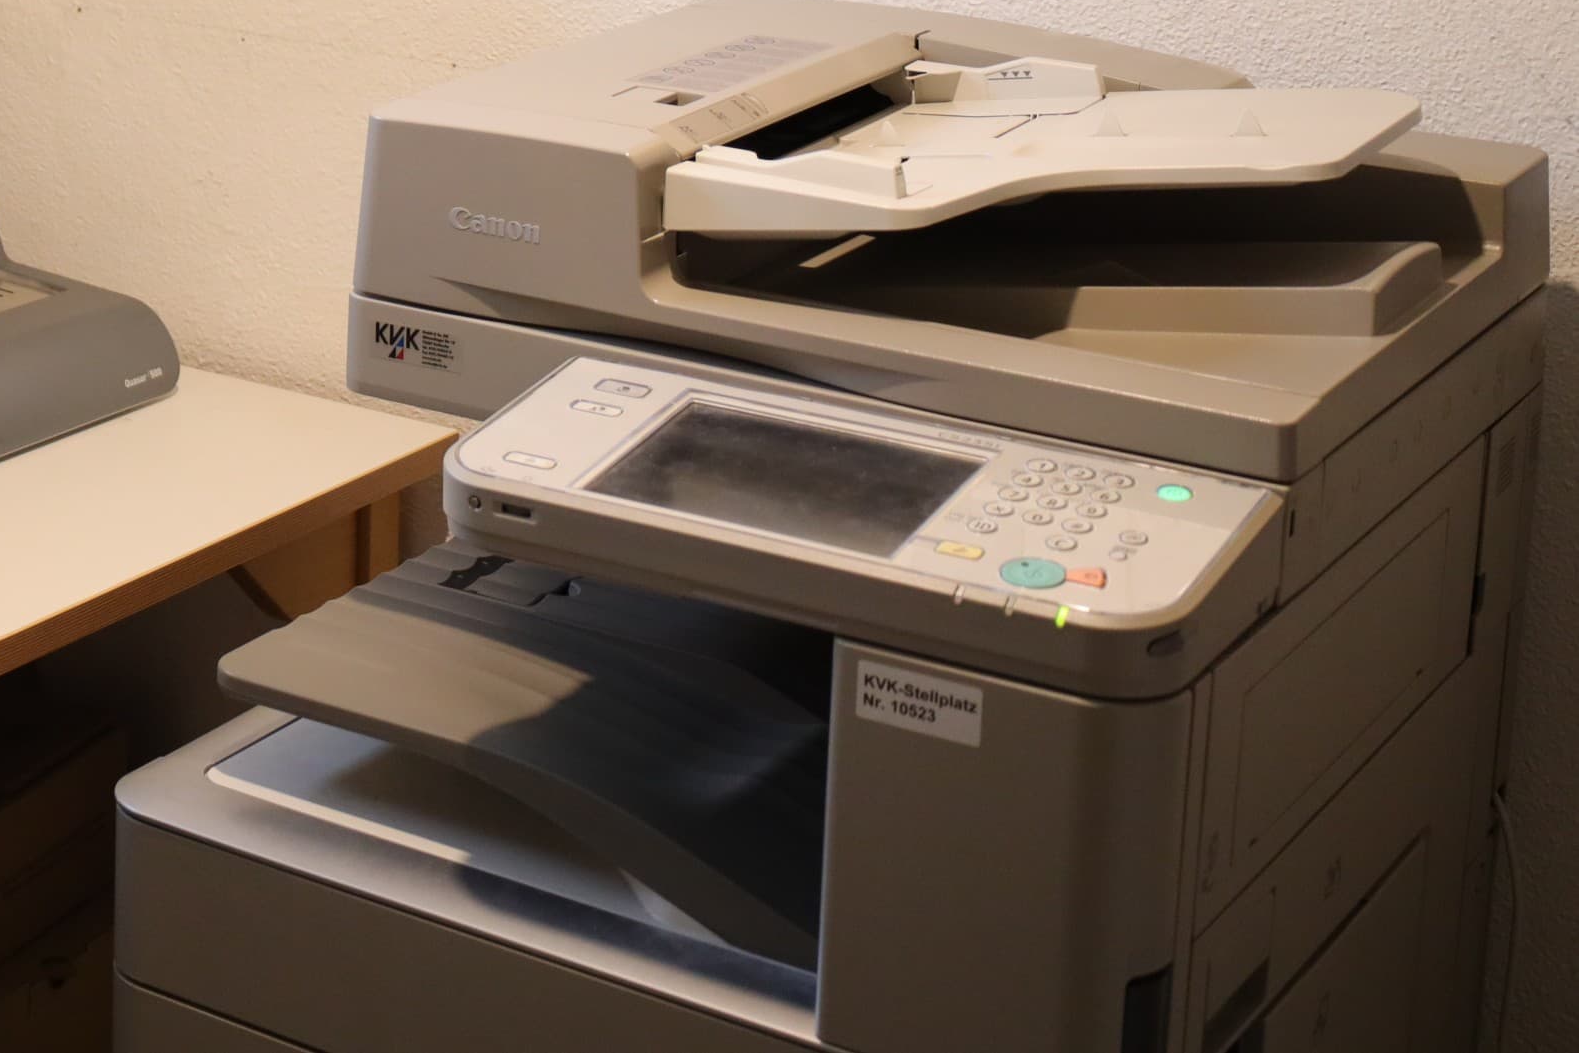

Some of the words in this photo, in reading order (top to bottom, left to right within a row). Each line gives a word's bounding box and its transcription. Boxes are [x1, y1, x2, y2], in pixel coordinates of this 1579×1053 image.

[448, 206, 541, 245] Canon
[375, 321, 421, 351] KVK
[863, 693, 885, 711] Nr.
[891, 700, 937, 723] 10523
[864, 673, 978, 714] KVK-Stellplatz
